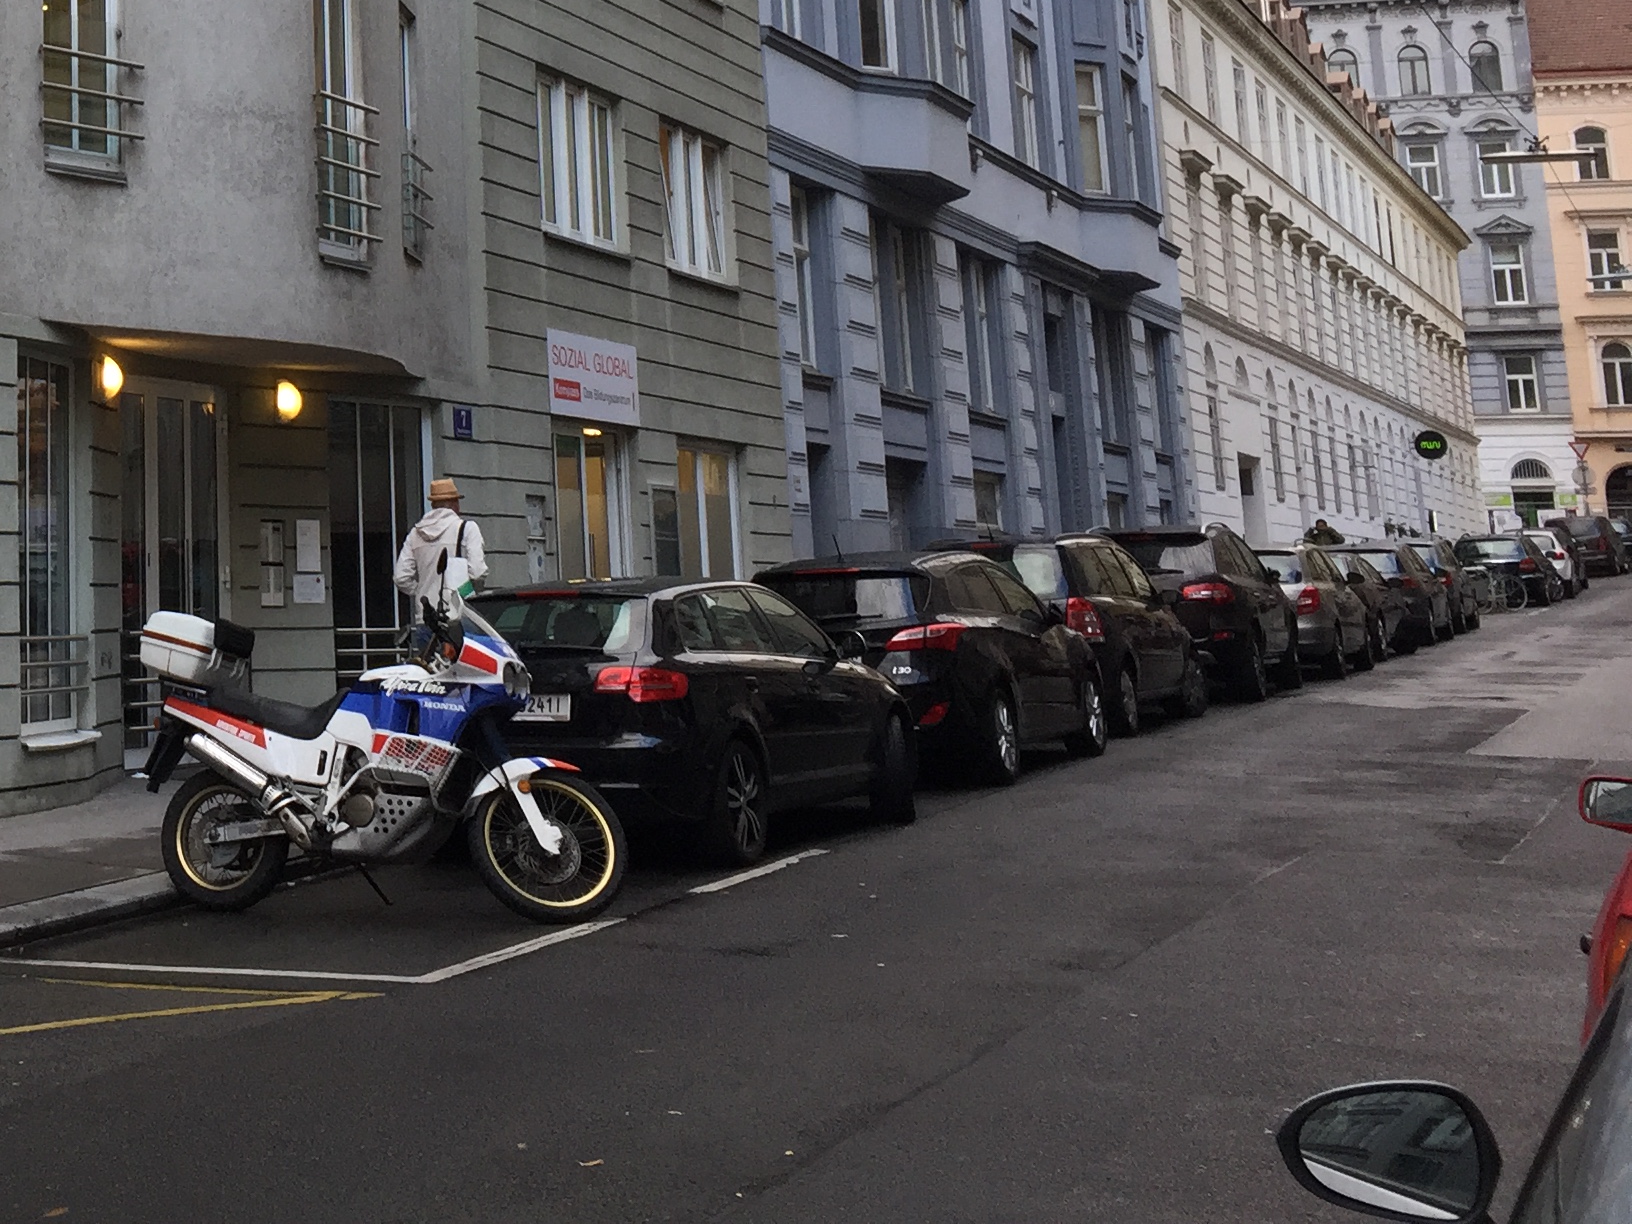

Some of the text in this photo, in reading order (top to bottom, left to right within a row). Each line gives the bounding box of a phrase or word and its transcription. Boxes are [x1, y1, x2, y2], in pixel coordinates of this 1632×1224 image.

[551, 344, 634, 380] SOZIAL GLOBAL
[423, 700, 467, 713] HONDA
